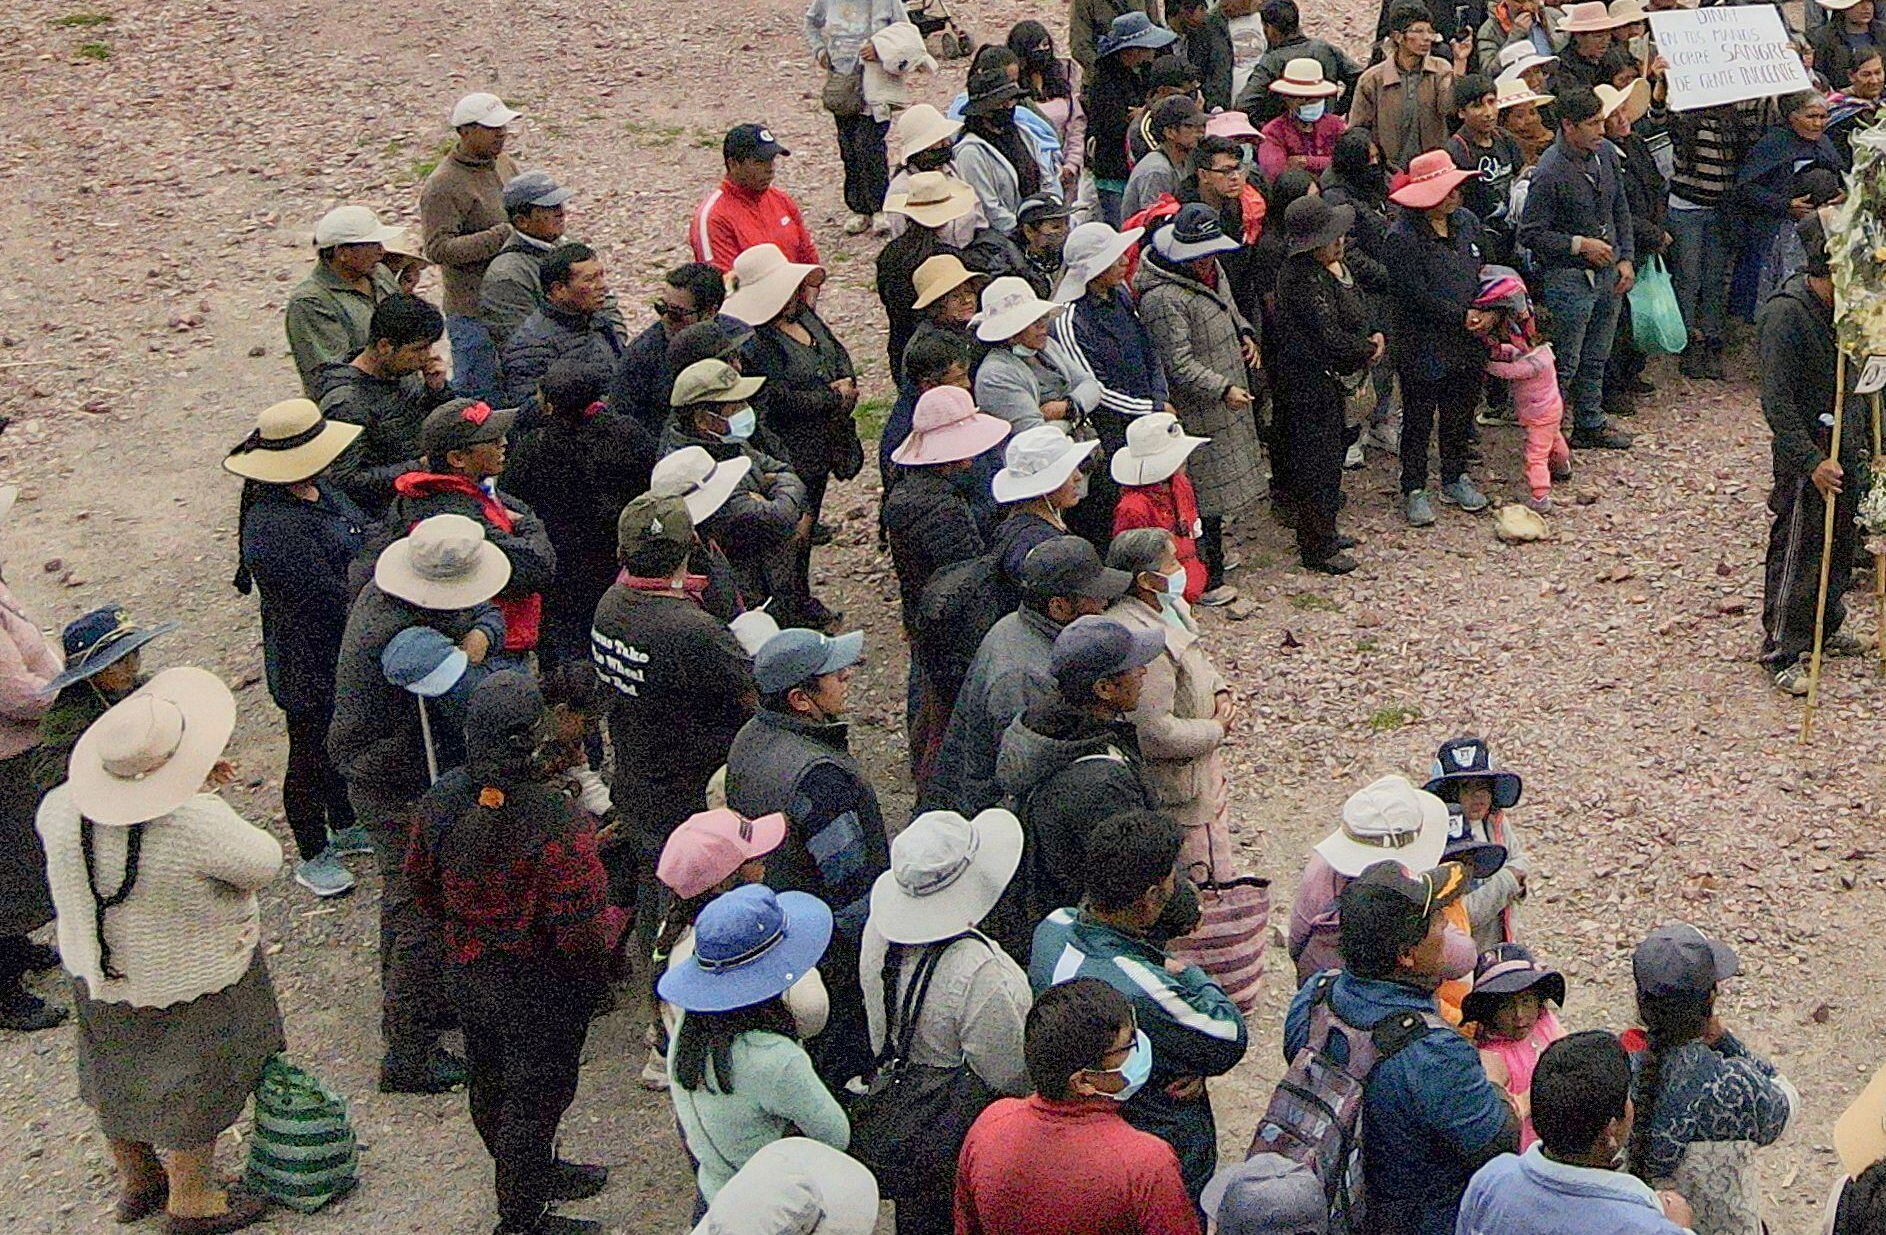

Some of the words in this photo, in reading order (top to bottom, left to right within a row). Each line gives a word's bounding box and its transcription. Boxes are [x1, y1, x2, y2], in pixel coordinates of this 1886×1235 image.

[1659, 31, 1678, 47] EN
[1713, 28, 1760, 43] MANOS
[1672, 50, 1711, 66] CORRE
[1721, 42, 1790, 63] SANGRE
[1674, 76, 1692, 92] DE
[1700, 70, 1735, 89] GENTE
[1740, 62, 1799, 86] INOCENTE
[615, 639, 649, 663] Take
[605, 655, 645, 682] Wheel
